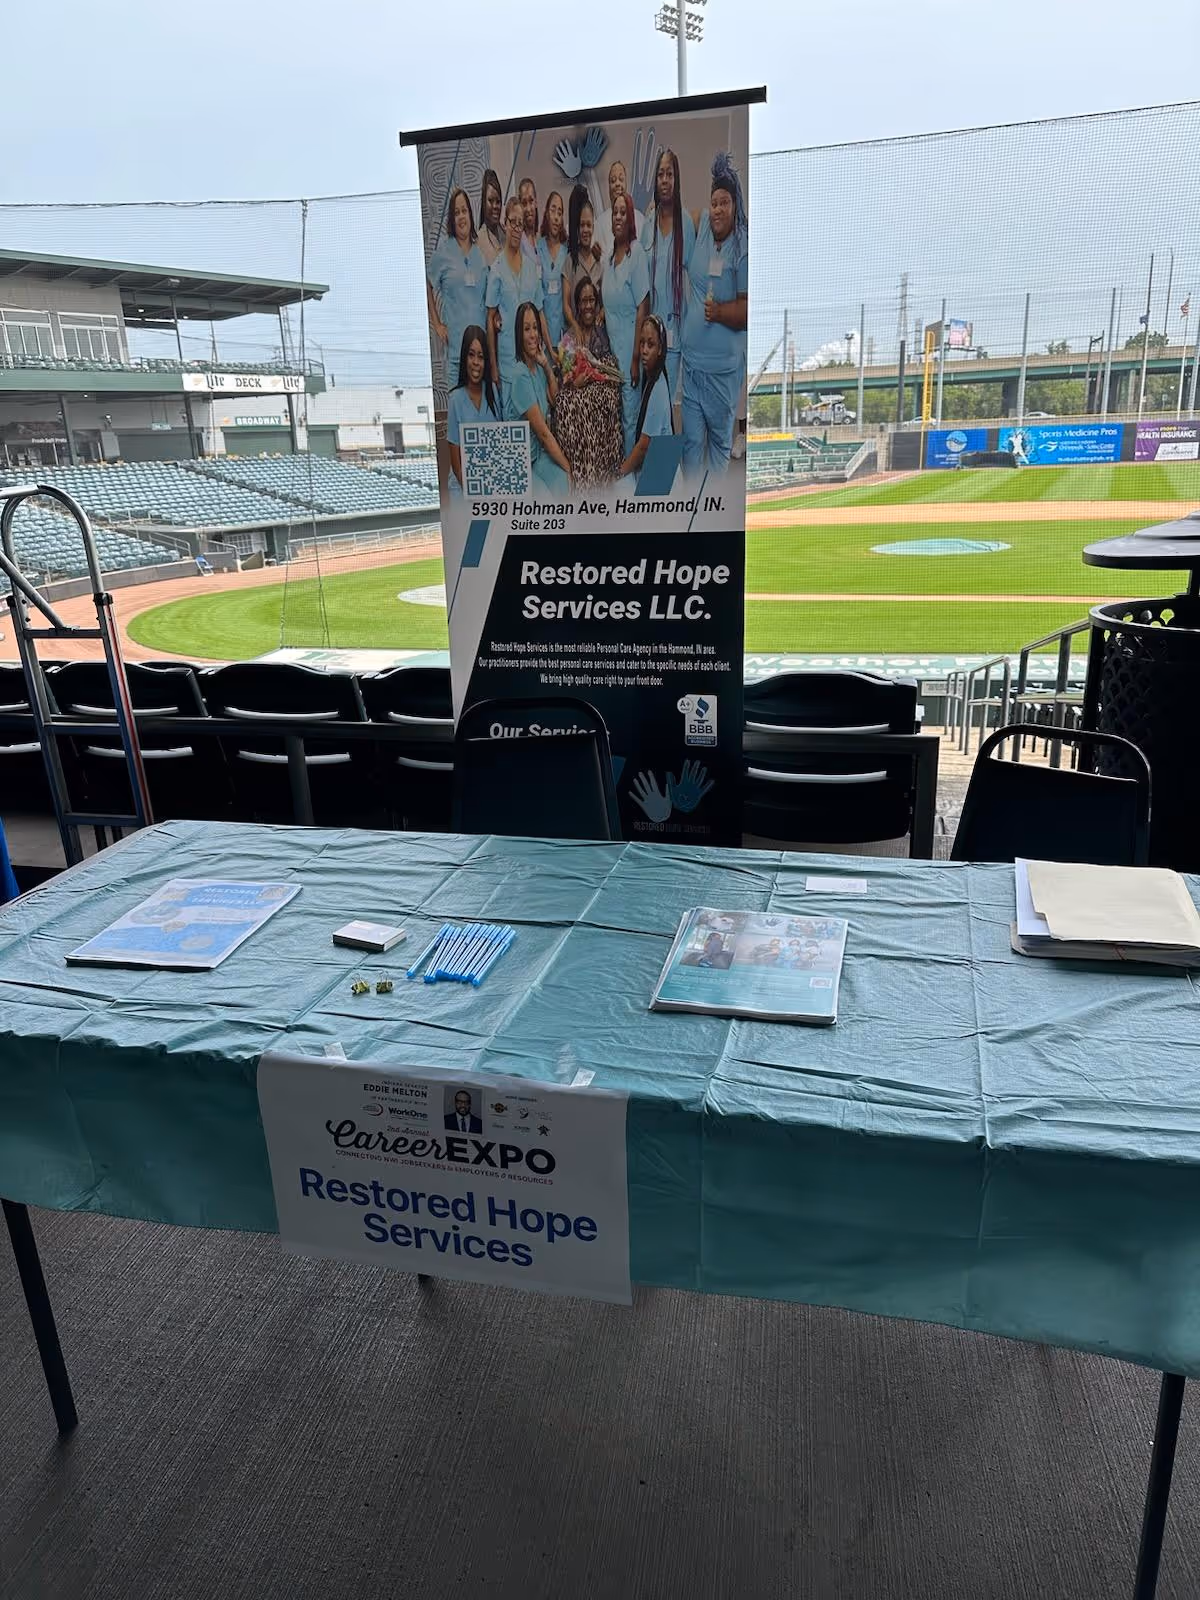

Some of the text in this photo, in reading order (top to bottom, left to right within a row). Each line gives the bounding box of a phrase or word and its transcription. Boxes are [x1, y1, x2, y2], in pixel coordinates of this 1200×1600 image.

[206, 375, 299, 390] Lite DECK Lite
[236, 416, 280, 425] BROADWAY
[1039, 427, 1118, 439] Sports Medicine Pros
[1136, 431, 1160, 439] HEALTH
[1160, 429, 1197, 439] INSURANCE
[472, 497, 726, 517] 5930 Hohman Ave, Hammond, IN.
[511, 518, 566, 531] Suite 203
[520, 558, 730, 591] Restored Hope
[522, 594, 712, 620] Services LLC.
[490, 641, 513, 652] Restored
[527, 641, 548, 653] Services
[549, 642, 554, 653] is
[554, 642, 563, 653] the
[563, 643, 577, 653] most
[577, 642, 596, 653] reliable
[596, 642, 619, 654] Personal
[620, 643, 632, 654] Care
[632, 643, 652, 656] Agency
[652, 643, 659, 654] in
[659, 643, 668, 654] the
[478, 657, 488, 668] Our
[488, 658, 519, 669] practitioners
[520, 658, 538, 669] provide
[539, 658, 548, 669] the
[548, 658, 559, 669] best
[560, 659, 581, 670] personal
[582, 660, 593, 669] care
[594, 659, 615, 670] services
[616, 659, 625, 670] and
[627, 660, 640, 670] cater
[640, 660, 647, 670] to
[647, 660, 656, 670] the
[656, 660, 677, 672] specific
[677, 660, 693, 671] needs
[694, 660, 701, 671] of
[700, 660, 713, 671] each
[714, 660, 731, 672] client.
[540, 673, 664, 687] We bring high quality care right to your front door.
[680, 699, 691, 707] A+
[489, 722, 523, 739] Our
[689, 724, 713, 734] BBB
[363, 1083, 428, 1098] EDDIE MELTON
[388, 1106, 429, 1120] WorkOne
[445, 1134, 556, 1175] EXPO
[335, 1149, 382, 1163] CONNECTING
[400, 1159, 446, 1171] JOBSEEKERS
[454, 1166, 499, 1179] EMPLOYERS
[507, 1174, 554, 1186] RESOURCES
[299, 1166, 598, 1244] Restored Hope
[363, 1212, 533, 1268] Services
